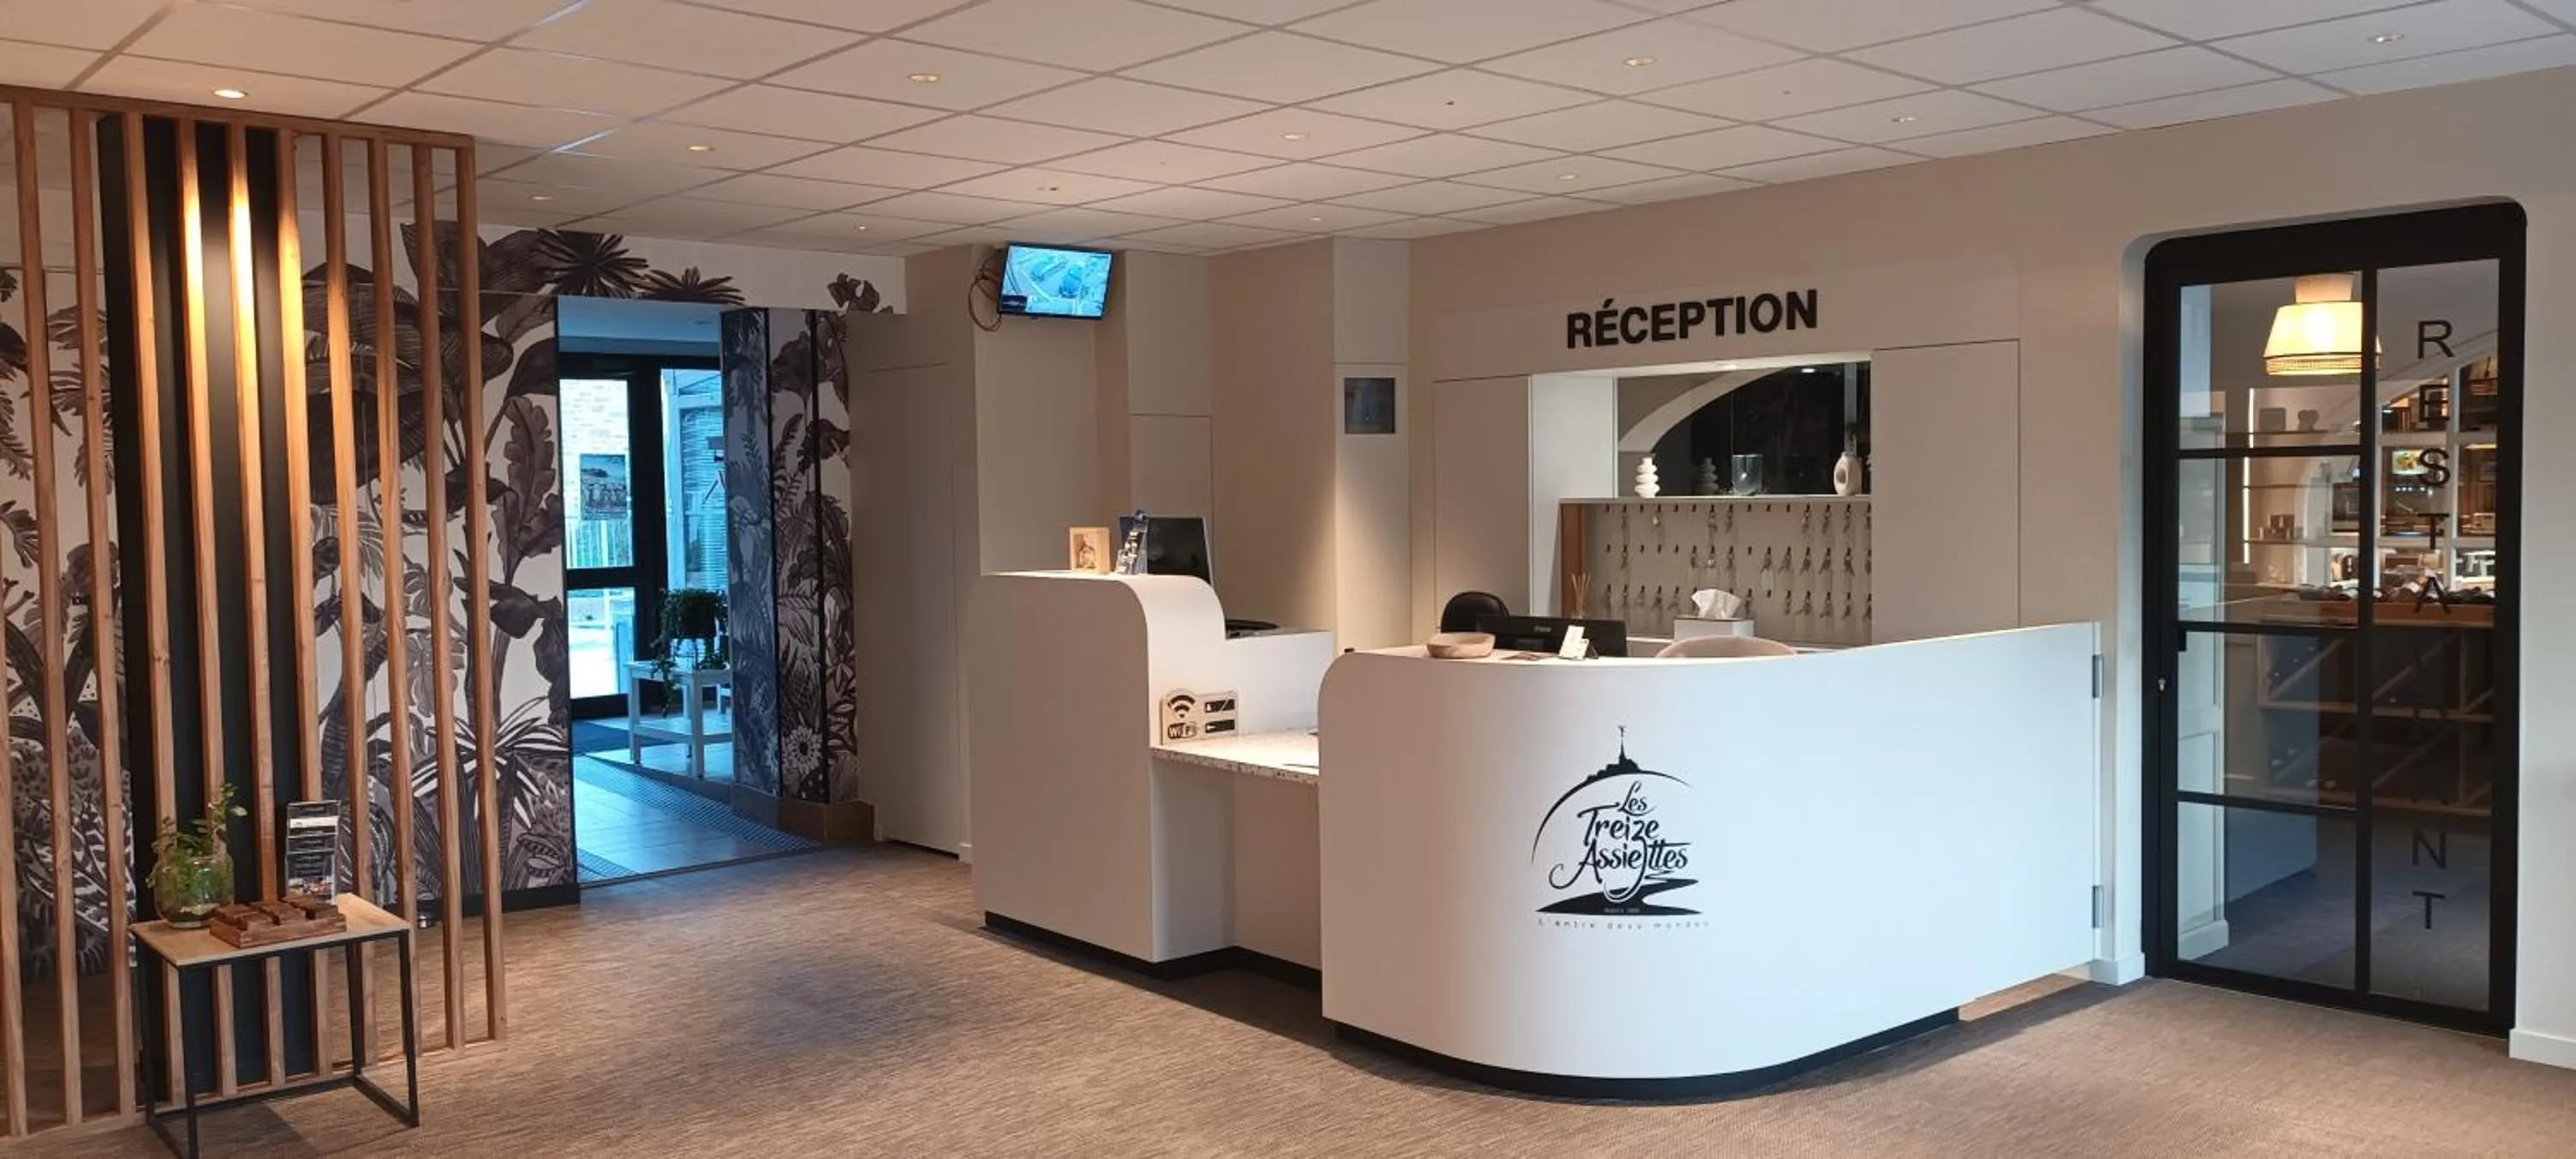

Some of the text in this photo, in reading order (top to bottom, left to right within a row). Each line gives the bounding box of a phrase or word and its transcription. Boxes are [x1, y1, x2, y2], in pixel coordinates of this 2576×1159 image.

[1566, 288, 1818, 349] RÉCEPTION
[2411, 318, 2456, 931] RESTANT
[1617, 780, 1657, 816] Les
[1549, 837, 1691, 889] Assiettes
